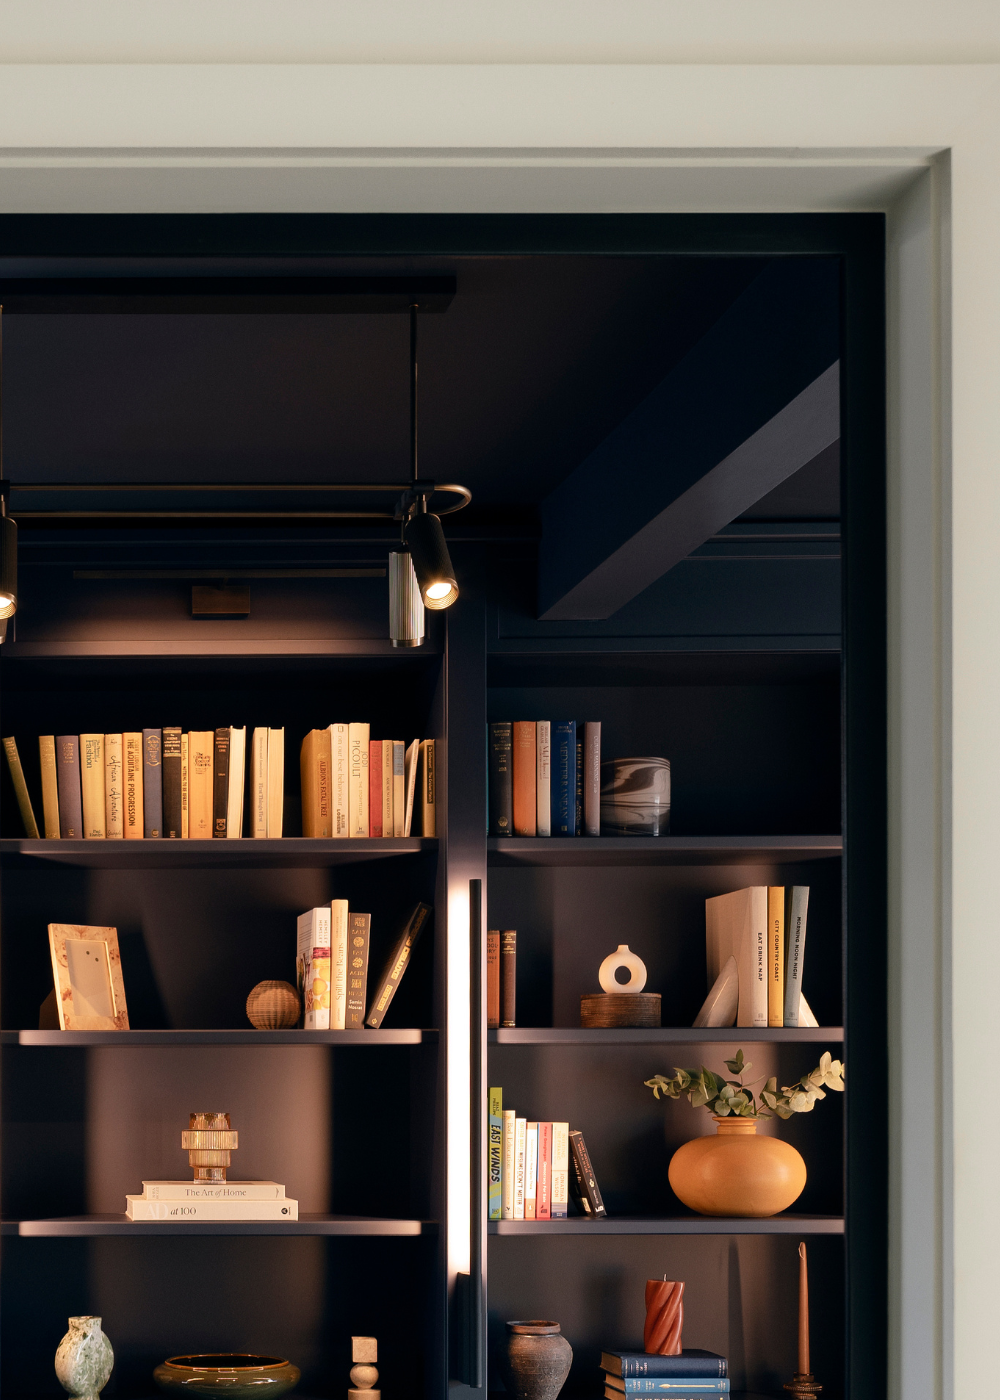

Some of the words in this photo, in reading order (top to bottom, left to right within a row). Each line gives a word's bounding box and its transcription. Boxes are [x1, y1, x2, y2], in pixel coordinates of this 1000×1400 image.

[107, 756, 120, 782] African
[127, 750, 135, 781] AQUITAINE
[352, 740, 360, 778] PICOULT
[559, 742, 568, 818] MEDITERRANEAN
[109, 788, 121, 822] Adventure
[336, 983, 344, 1000] Spill
[491, 1125, 501, 1145] EAST
[490, 1147, 501, 1183] WINDS
[215, 1189, 223, 1197] of
[146, 1203, 168, 1219] AD
[181, 1207, 196, 1215] 100
